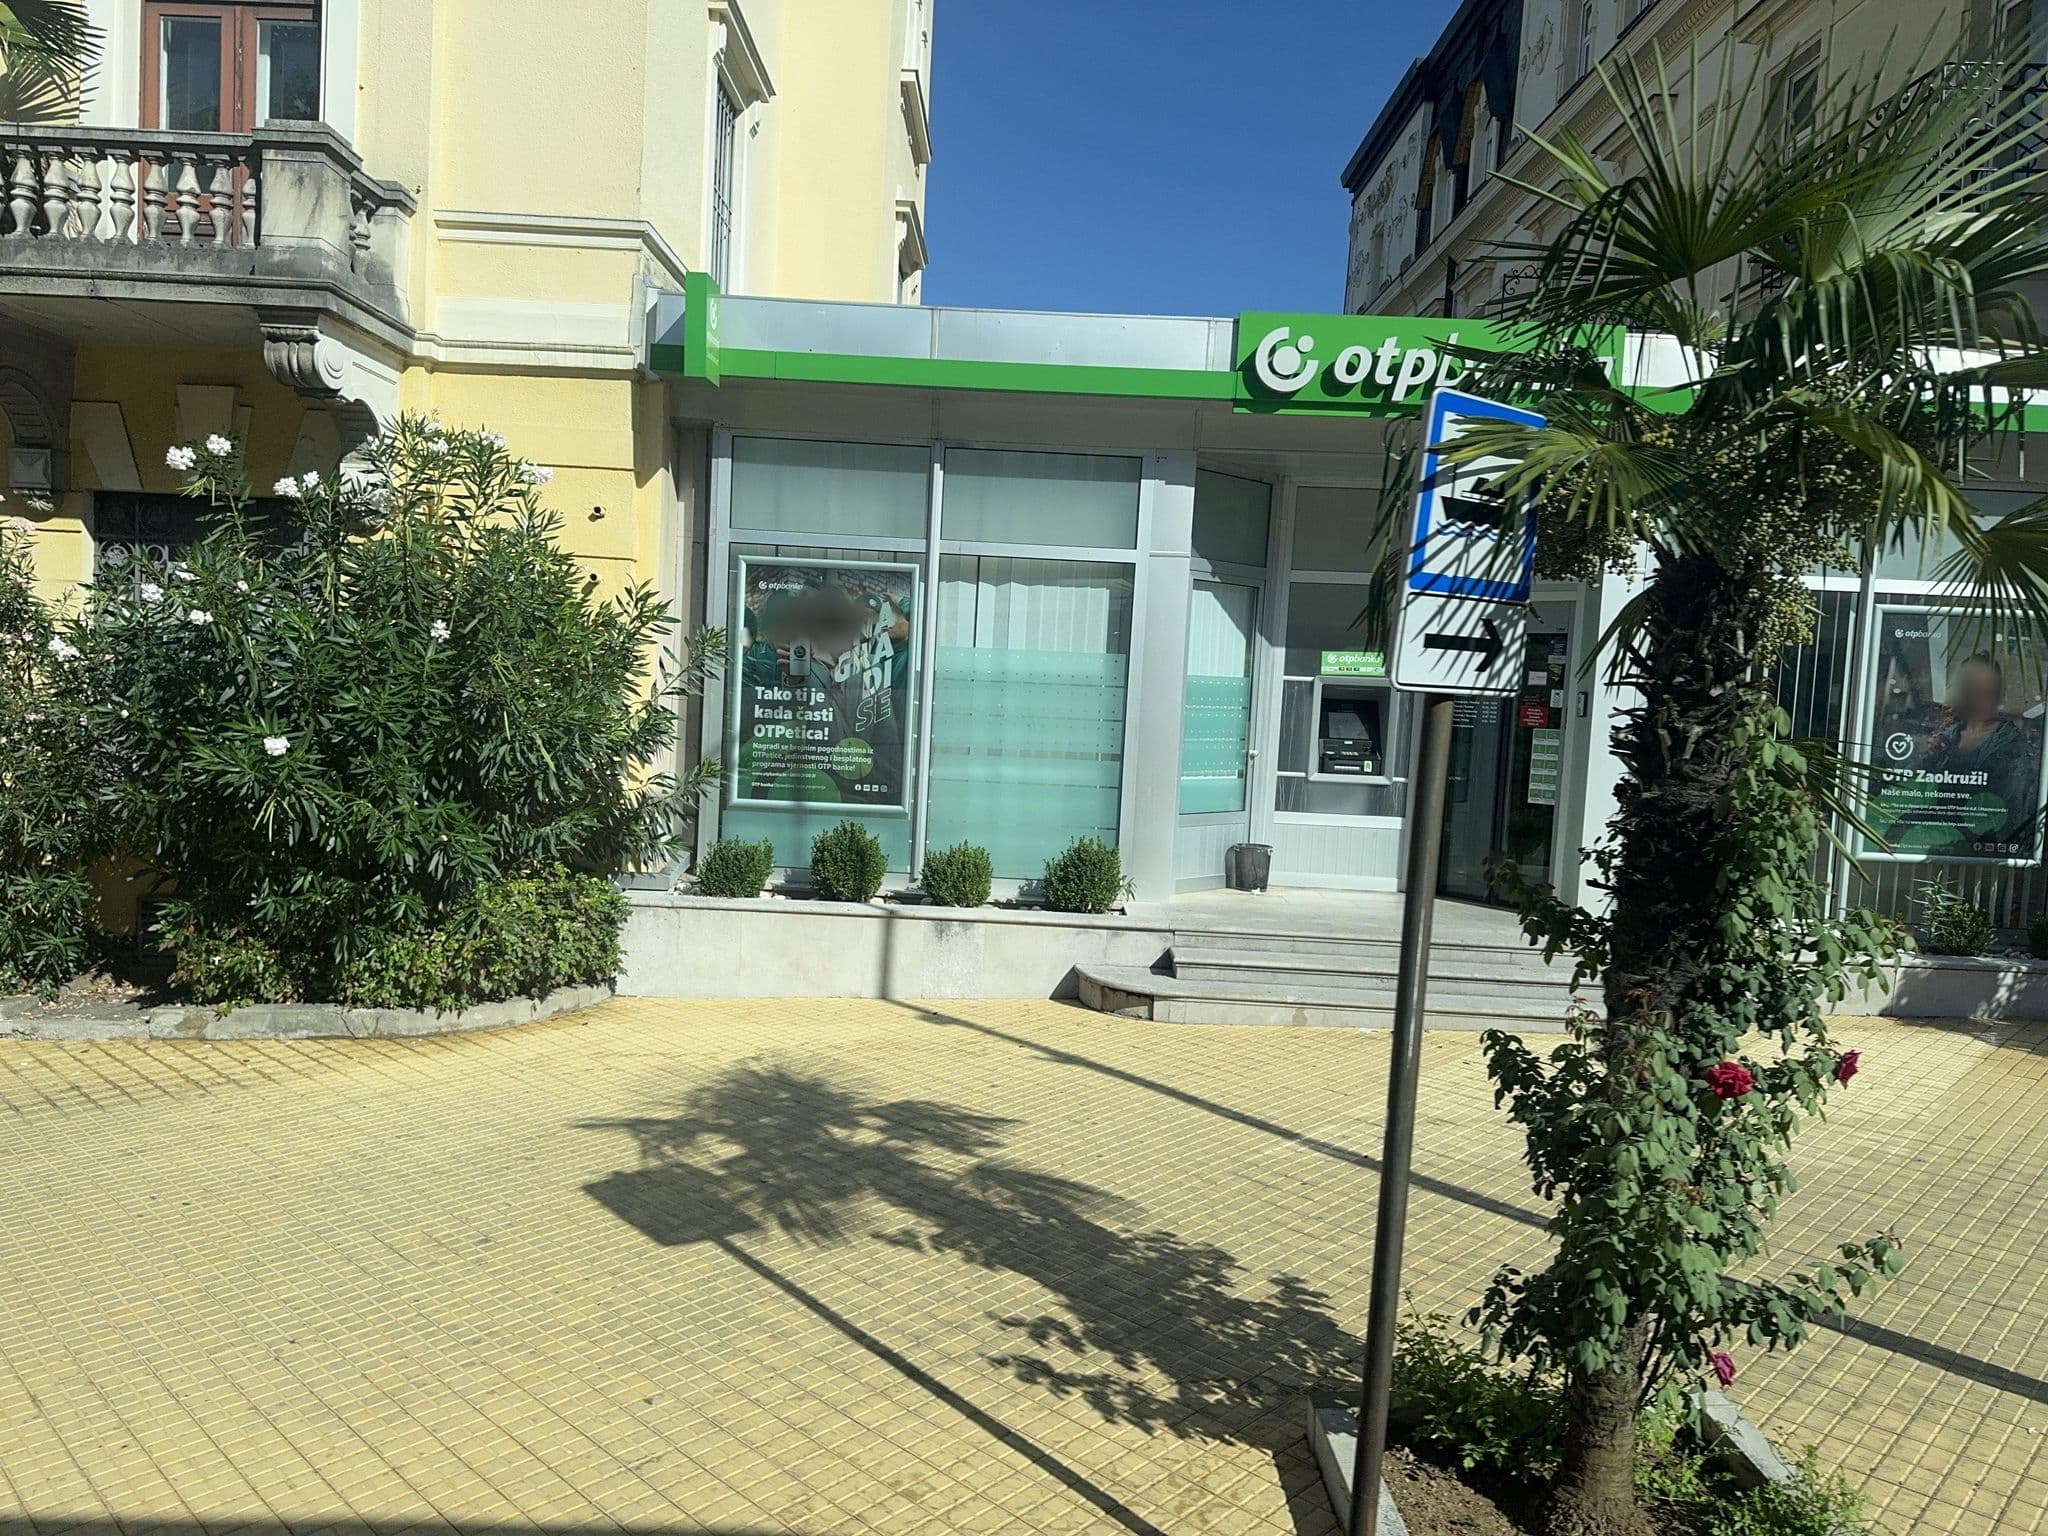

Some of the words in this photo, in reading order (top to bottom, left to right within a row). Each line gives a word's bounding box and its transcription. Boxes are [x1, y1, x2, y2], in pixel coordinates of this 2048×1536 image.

[754, 686, 793, 701] Tako
[795, 688, 808, 702] ti
[809, 687, 826, 706] je
[754, 704, 793, 720] kada
[796, 706, 834, 722] časti
[856, 688, 893, 732] SE
[753, 723, 830, 741] OTPetica!
[752, 742, 780, 752] Nagradi
[789, 744, 816, 753] brojnim
[817, 745, 867, 755] pogodnostima
[752, 761, 786, 770] programa
[786, 761, 817, 771] vjernosti
[784, 752, 829, 762] jedinstvenog
[833, 755, 872, 765] besplatnog
[1915, 769, 1988, 785] Zaokruži!
[1880, 788, 1901, 797] Naše
[1902, 789, 1924, 798] malo,
[1924, 790, 1957, 799] nekome
[1957, 792, 1973, 800] sve.
